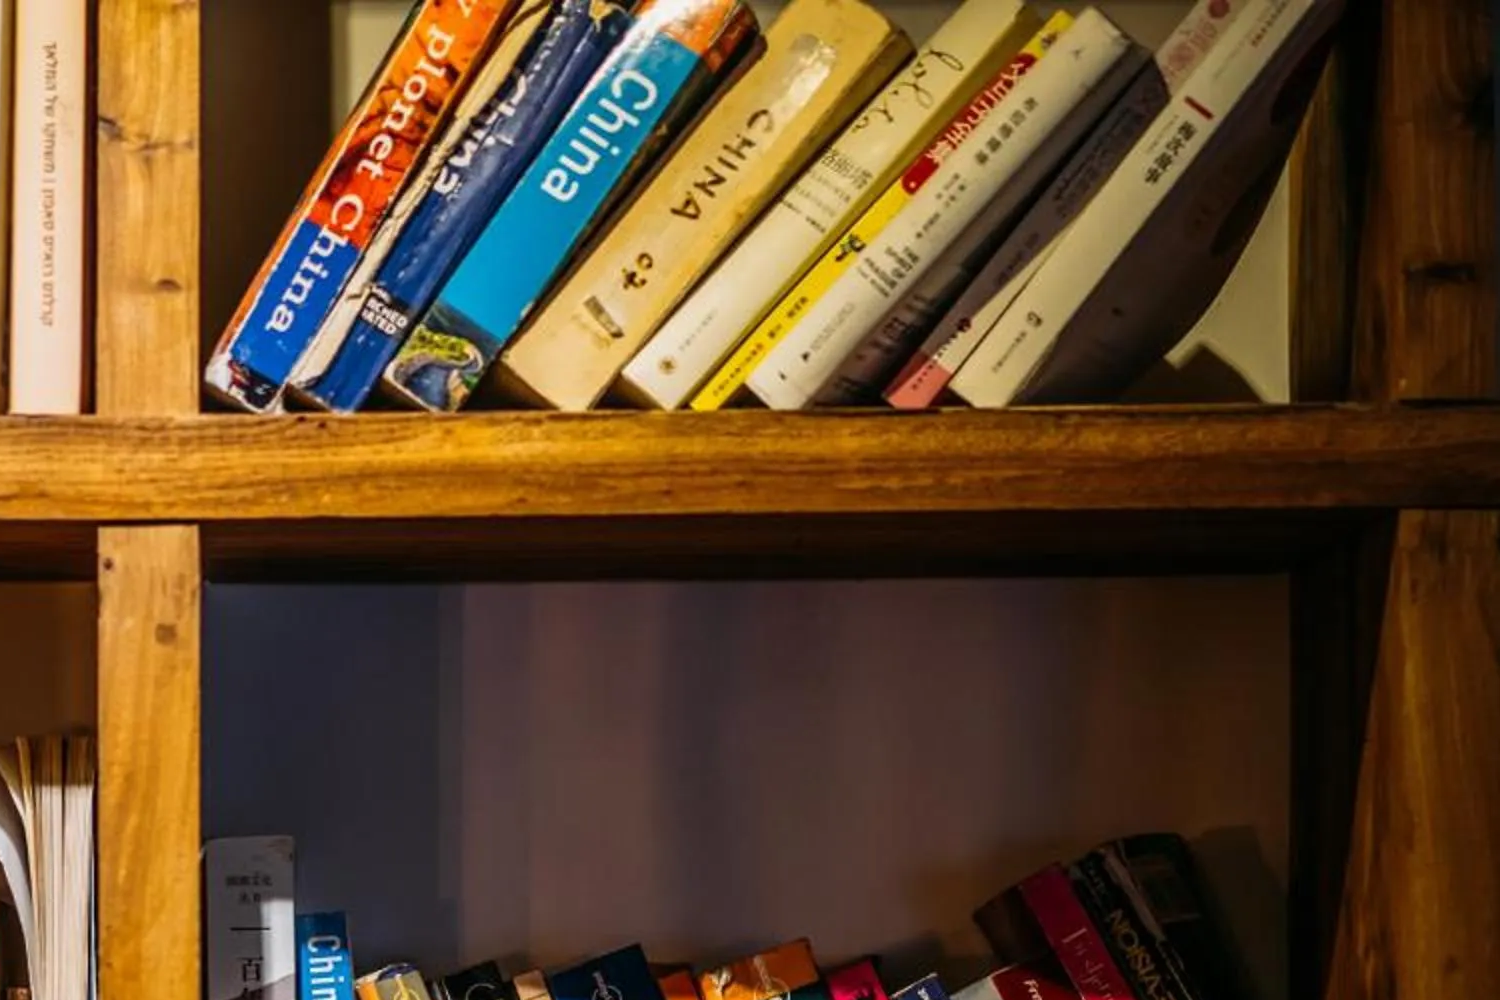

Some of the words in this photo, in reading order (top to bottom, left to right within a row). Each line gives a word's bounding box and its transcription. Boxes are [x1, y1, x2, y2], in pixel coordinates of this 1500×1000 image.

[539, 67, 661, 204] China
[669, 104, 780, 228] CHINA
[263, 188, 369, 342] China
[1108, 908, 1161, 990] VISION
